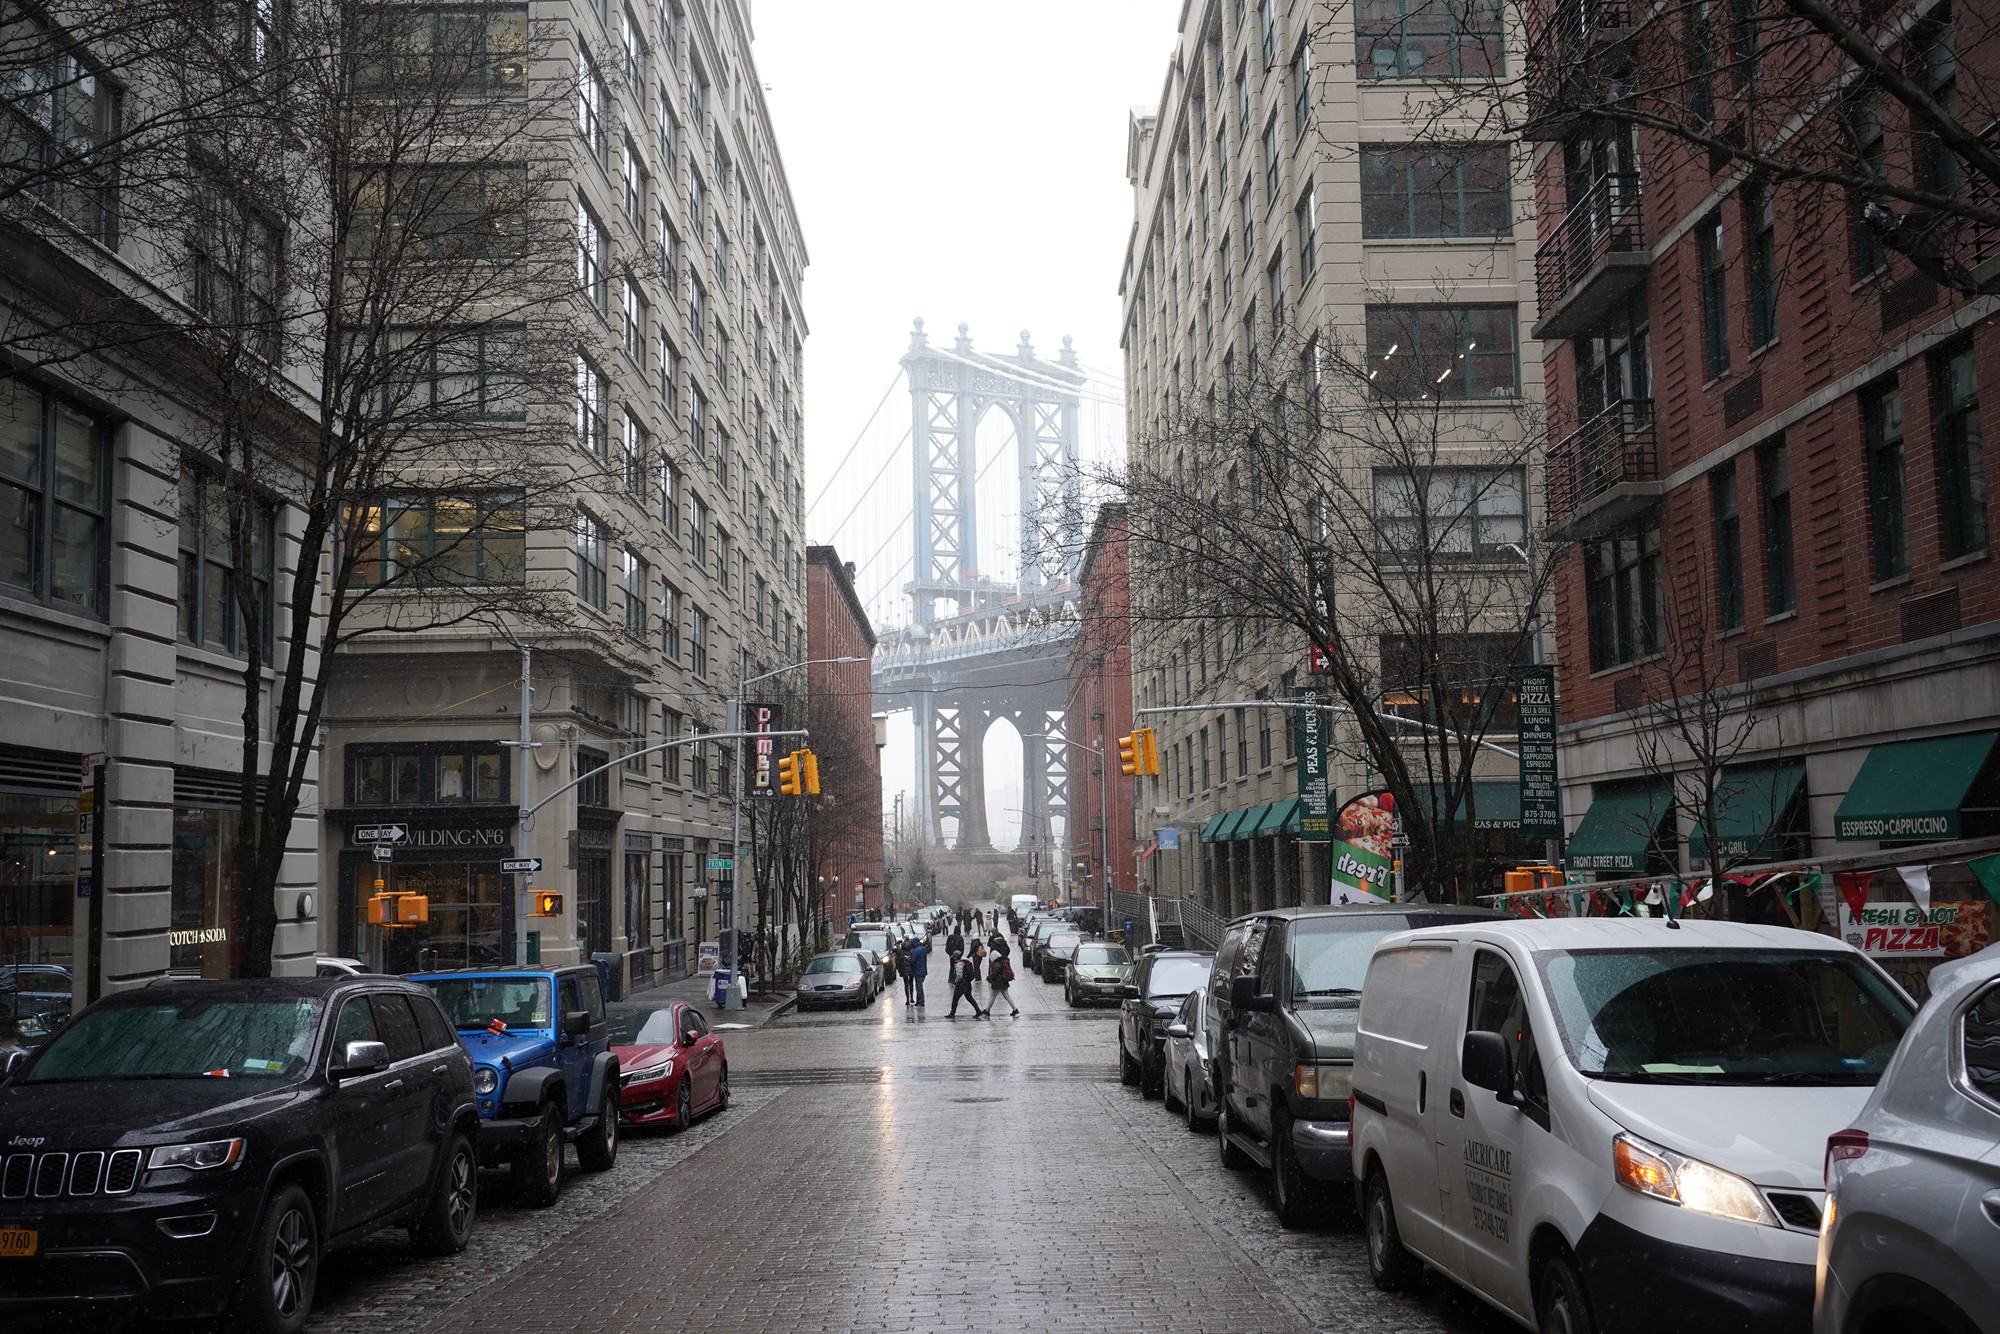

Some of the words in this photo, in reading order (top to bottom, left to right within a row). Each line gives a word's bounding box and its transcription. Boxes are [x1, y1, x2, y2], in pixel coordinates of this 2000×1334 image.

[1522, 685, 1549, 693] STREET
[1520, 693, 1551, 704] PIZZA
[1304, 691, 1318, 734] PICKRS
[756, 707, 773, 787] DUMBO
[1523, 745, 1536, 753] BEER
[1540, 745, 1553, 753] WINE
[1306, 746, 1319, 774] PEAS
[1526, 760, 1551, 768] ESPRESSO
[1525, 774, 1541, 782] GLUTEN
[1528, 782, 1551, 790] PRODUCTS
[1523, 789, 1535, 797] FREE
[1535, 789, 1556, 797] DELIVERY
[1524, 810, 1556, 818] 875-3700
[1474, 820, 1491, 829] EAS
[1492, 820, 1501, 829] &
[1841, 819, 1885, 837] ESSPRESSO
[1888, 816, 1948, 835] CAPPUCCINO
[360, 830, 375, 838] ONE
[379, 830, 392, 838] AY
[397, 829, 472, 846] VILDING
[1728, 841, 1748, 855] GRILL
[708, 860, 725, 868] FRONT
[1573, 856, 1592, 868] FRONT
[1593, 855, 1614, 868] STREET
[1615, 855, 1634, 868] PIZZA
[433, 878, 461, 887] GUNN
[1903, 908, 1919, 925] &
[1922, 907, 1958, 924] HOT
[170, 930, 198, 946] COTCH
[205, 928, 227, 943] SODA
[1864, 926, 1941, 952] PIZZA
[8, 1135, 45, 1148] Jeep
[1463, 1138, 1512, 1175] AMERICARE
